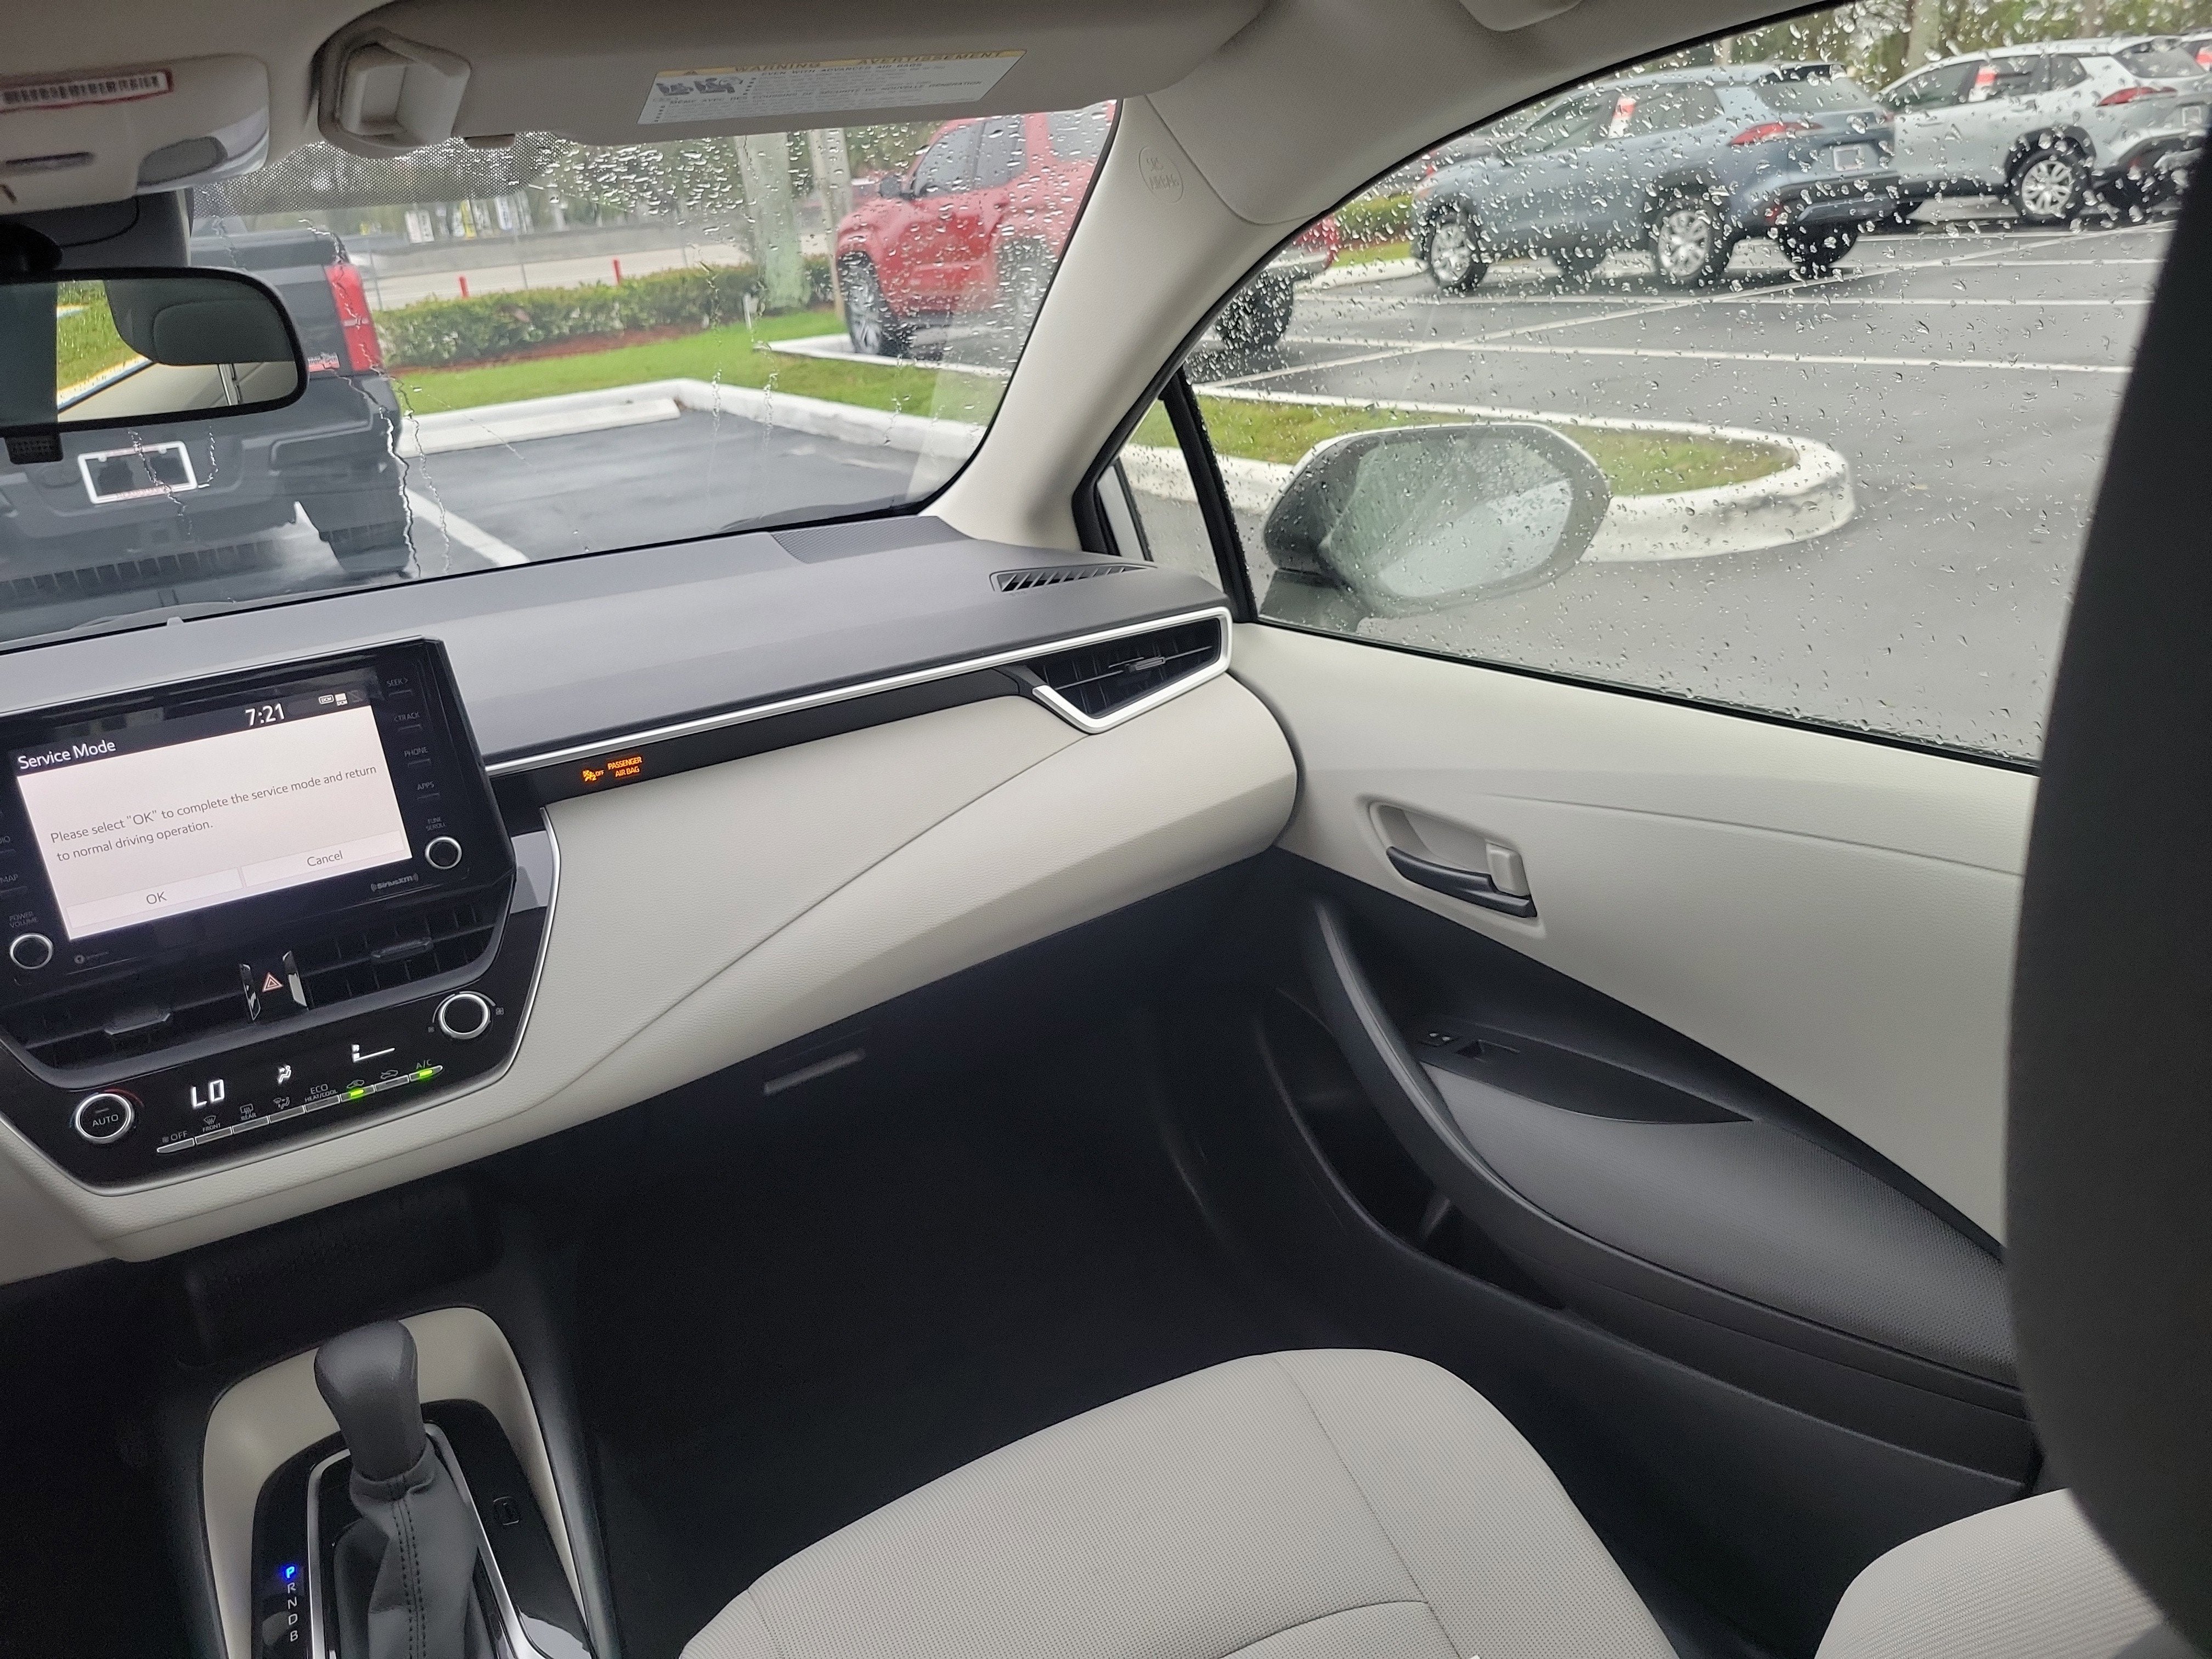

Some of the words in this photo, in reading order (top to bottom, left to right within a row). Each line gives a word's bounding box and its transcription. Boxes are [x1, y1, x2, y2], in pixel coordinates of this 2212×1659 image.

[245, 703, 285, 726] 7:21
[18, 751, 71, 769] Service
[72, 740, 116, 758] Mode
[404, 747, 428, 757] PHONE
[607, 757, 642, 770] PASSENGER
[615, 769, 626, 777] AIR
[626, 766, 640, 775] BAG
[417, 781, 435, 791] APPS
[50, 831, 89, 843] Please
[92, 820, 126, 834] select
[126, 810, 157, 825] "OK"
[161, 810, 174, 819] to
[177, 798, 229, 813] complete
[230, 794, 249, 804] the
[251, 786, 289, 800] service
[291, 777, 321, 791] mode
[323, 771, 343, 784] and
[345, 766, 376, 780] return
[57, 852, 70, 861] to
[73, 840, 112, 857] normal
[115, 834, 154, 848] driving
[156, 821, 213, 840] operation.
[307, 850, 343, 866] Cancel
[146, 891, 167, 905] OK
[9, 911, 34, 921] POWER
[9, 917, 38, 928] VOLUME
[416, 1059, 432, 1069] A/C
[190, 1079, 225, 1108] LO
[310, 1083, 329, 1095] ECO
[304, 1089, 338, 1103] HEAT/COOL
[92, 1114, 119, 1127] AUTO
[241, 1113, 257, 1121] REAR
[202, 1122, 221, 1132] FRONT
[171, 1130, 188, 1141] OFF
[286, 1566, 295, 1578] P
[287, 1582, 296, 1594] R
[287, 1596, 297, 1610] N
[288, 1613, 298, 1626] D
[290, 1630, 298, 1642] B
